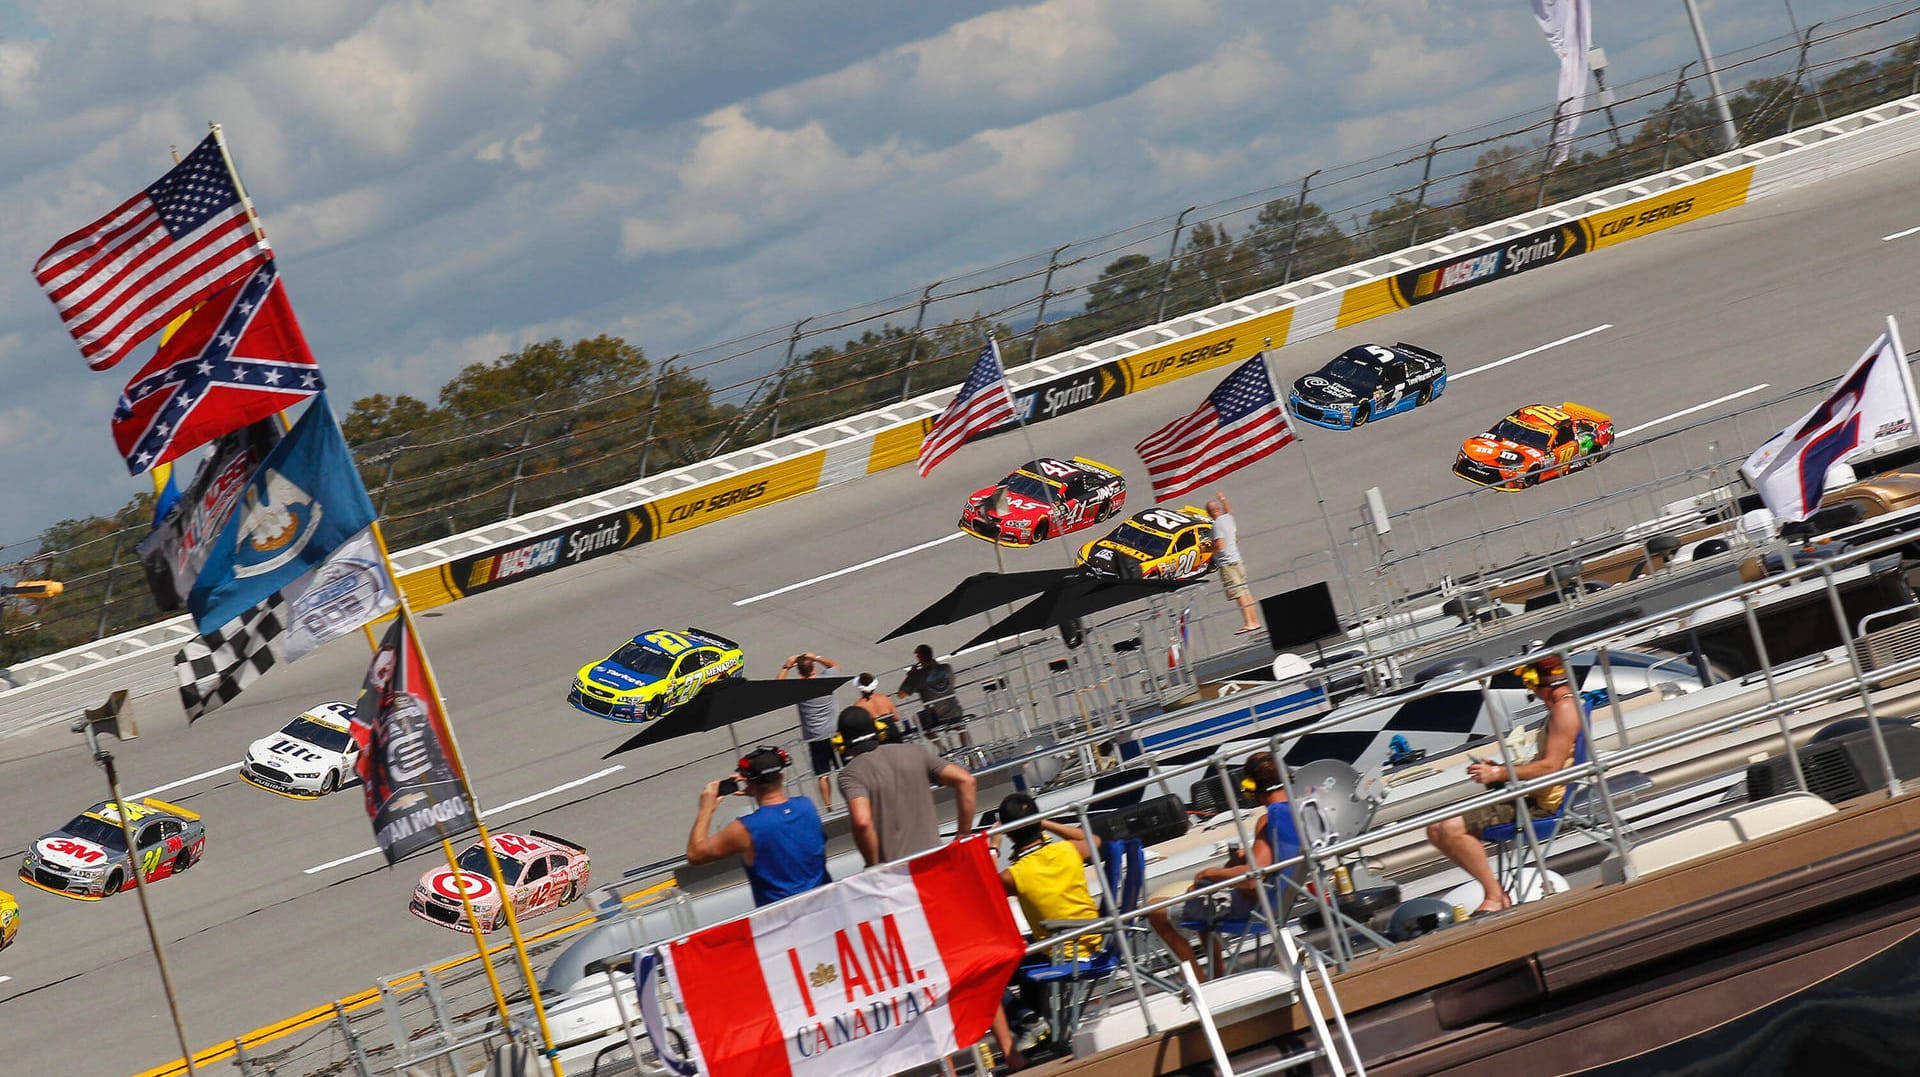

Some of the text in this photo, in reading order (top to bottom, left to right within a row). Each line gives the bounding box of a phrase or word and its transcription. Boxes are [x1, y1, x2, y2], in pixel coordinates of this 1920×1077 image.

[1440, 198, 1695, 291] NASCAR Sprint CUP SERIES
[1364, 345, 1394, 363] 5
[1042, 377, 1096, 418] Sprint
[1139, 360, 1175, 379] CUP
[1176, 338, 1236, 367] SERIES
[1386, 383, 1405, 410] 5
[1524, 405, 1571, 425] 18
[1040, 460, 1079, 478] 41
[1066, 500, 1087, 524] 41
[1142, 510, 1192, 530] 20
[497, 481, 768, 580] NASCAR Sprint CUP SERIES
[1175, 550, 1197, 578] 20
[644, 631, 692, 655] 27
[705, 656, 738, 678] MENARDS
[678, 671, 703, 701] 27
[267, 740, 323, 763] Lite
[46, 839, 104, 863] 3M
[495, 834, 542, 856] 42
[141, 846, 163, 874] 24
[528, 881, 551, 908] 42
[787, 913, 927, 1018] I AM.
[796, 983, 938, 1058] CANADIAN
